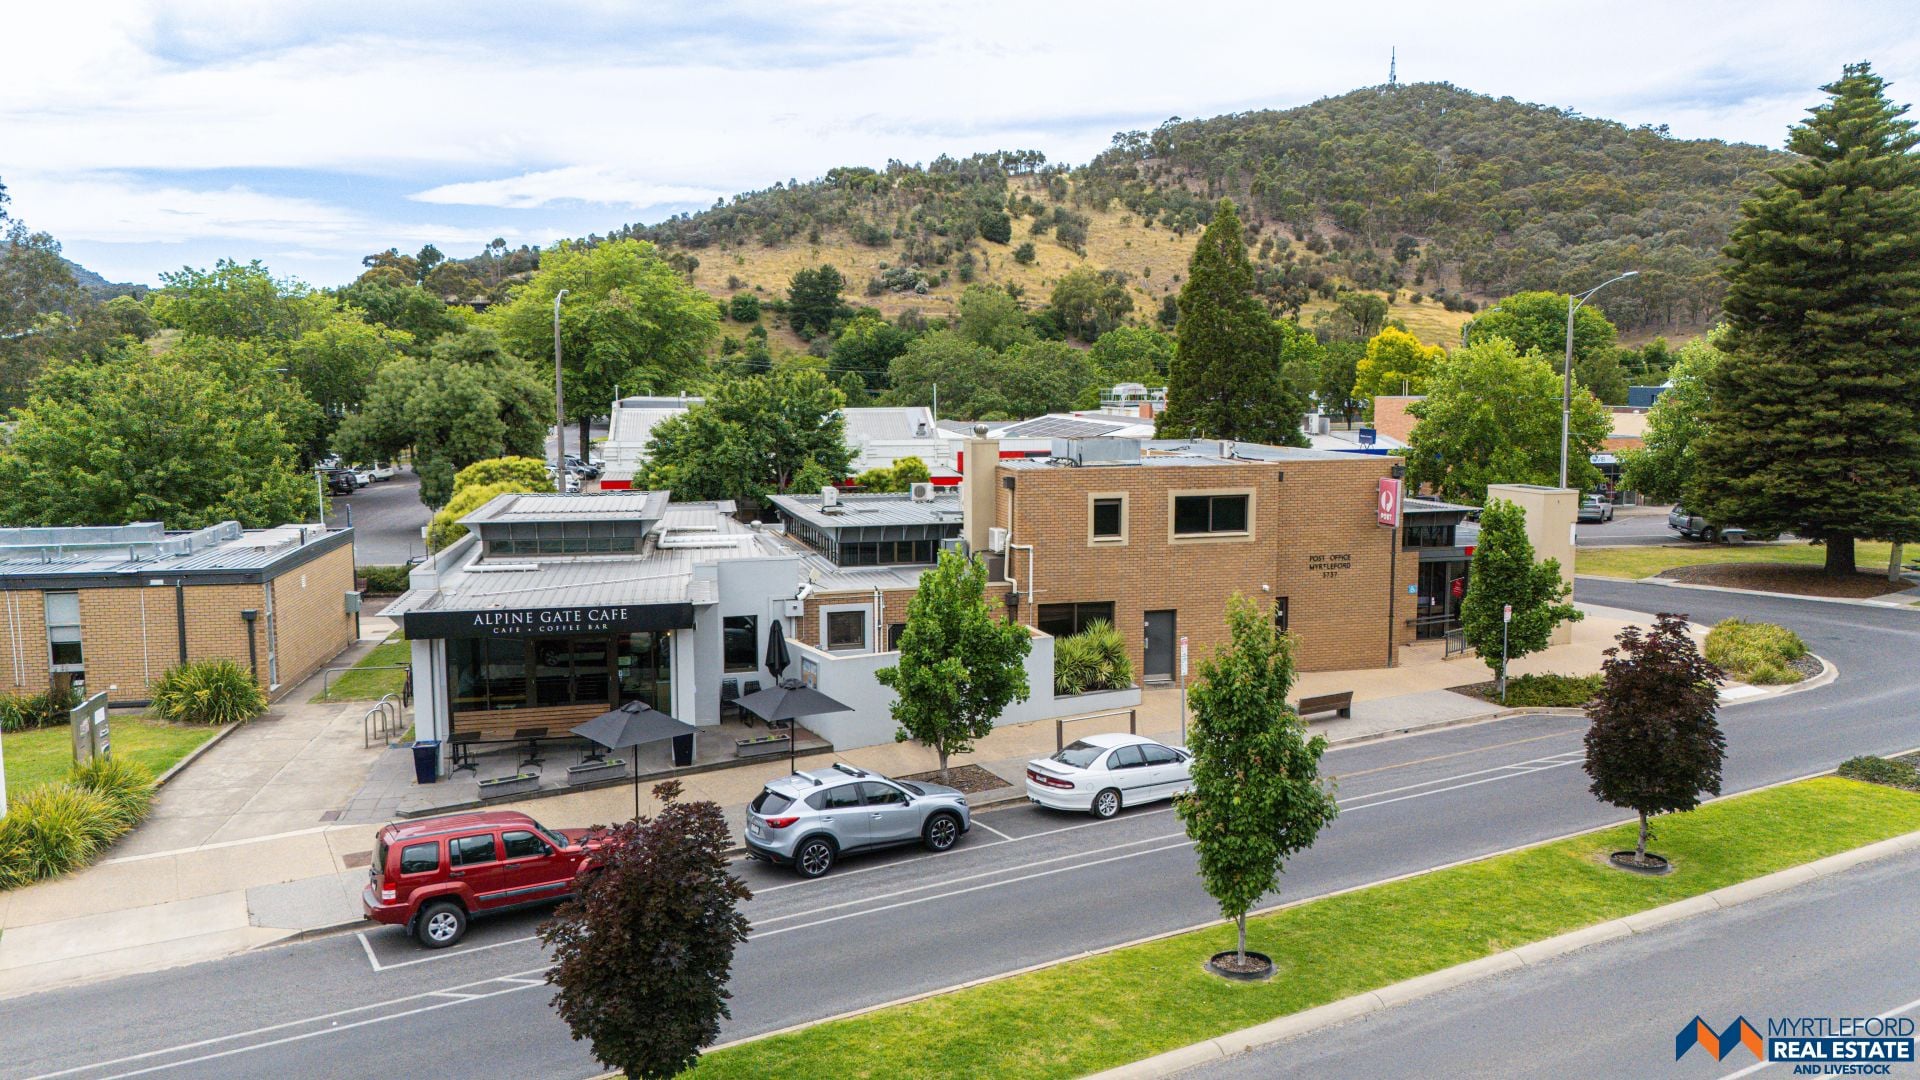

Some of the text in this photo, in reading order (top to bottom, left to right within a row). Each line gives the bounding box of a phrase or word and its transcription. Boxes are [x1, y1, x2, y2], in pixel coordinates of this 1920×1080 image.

[1330, 553, 1351, 561] OFFICE
[1309, 562, 1351, 570] MYRTLEFORD
[473, 608, 628, 626] ALPINE GATE CAFE
[493, 626, 520, 634] CAFE
